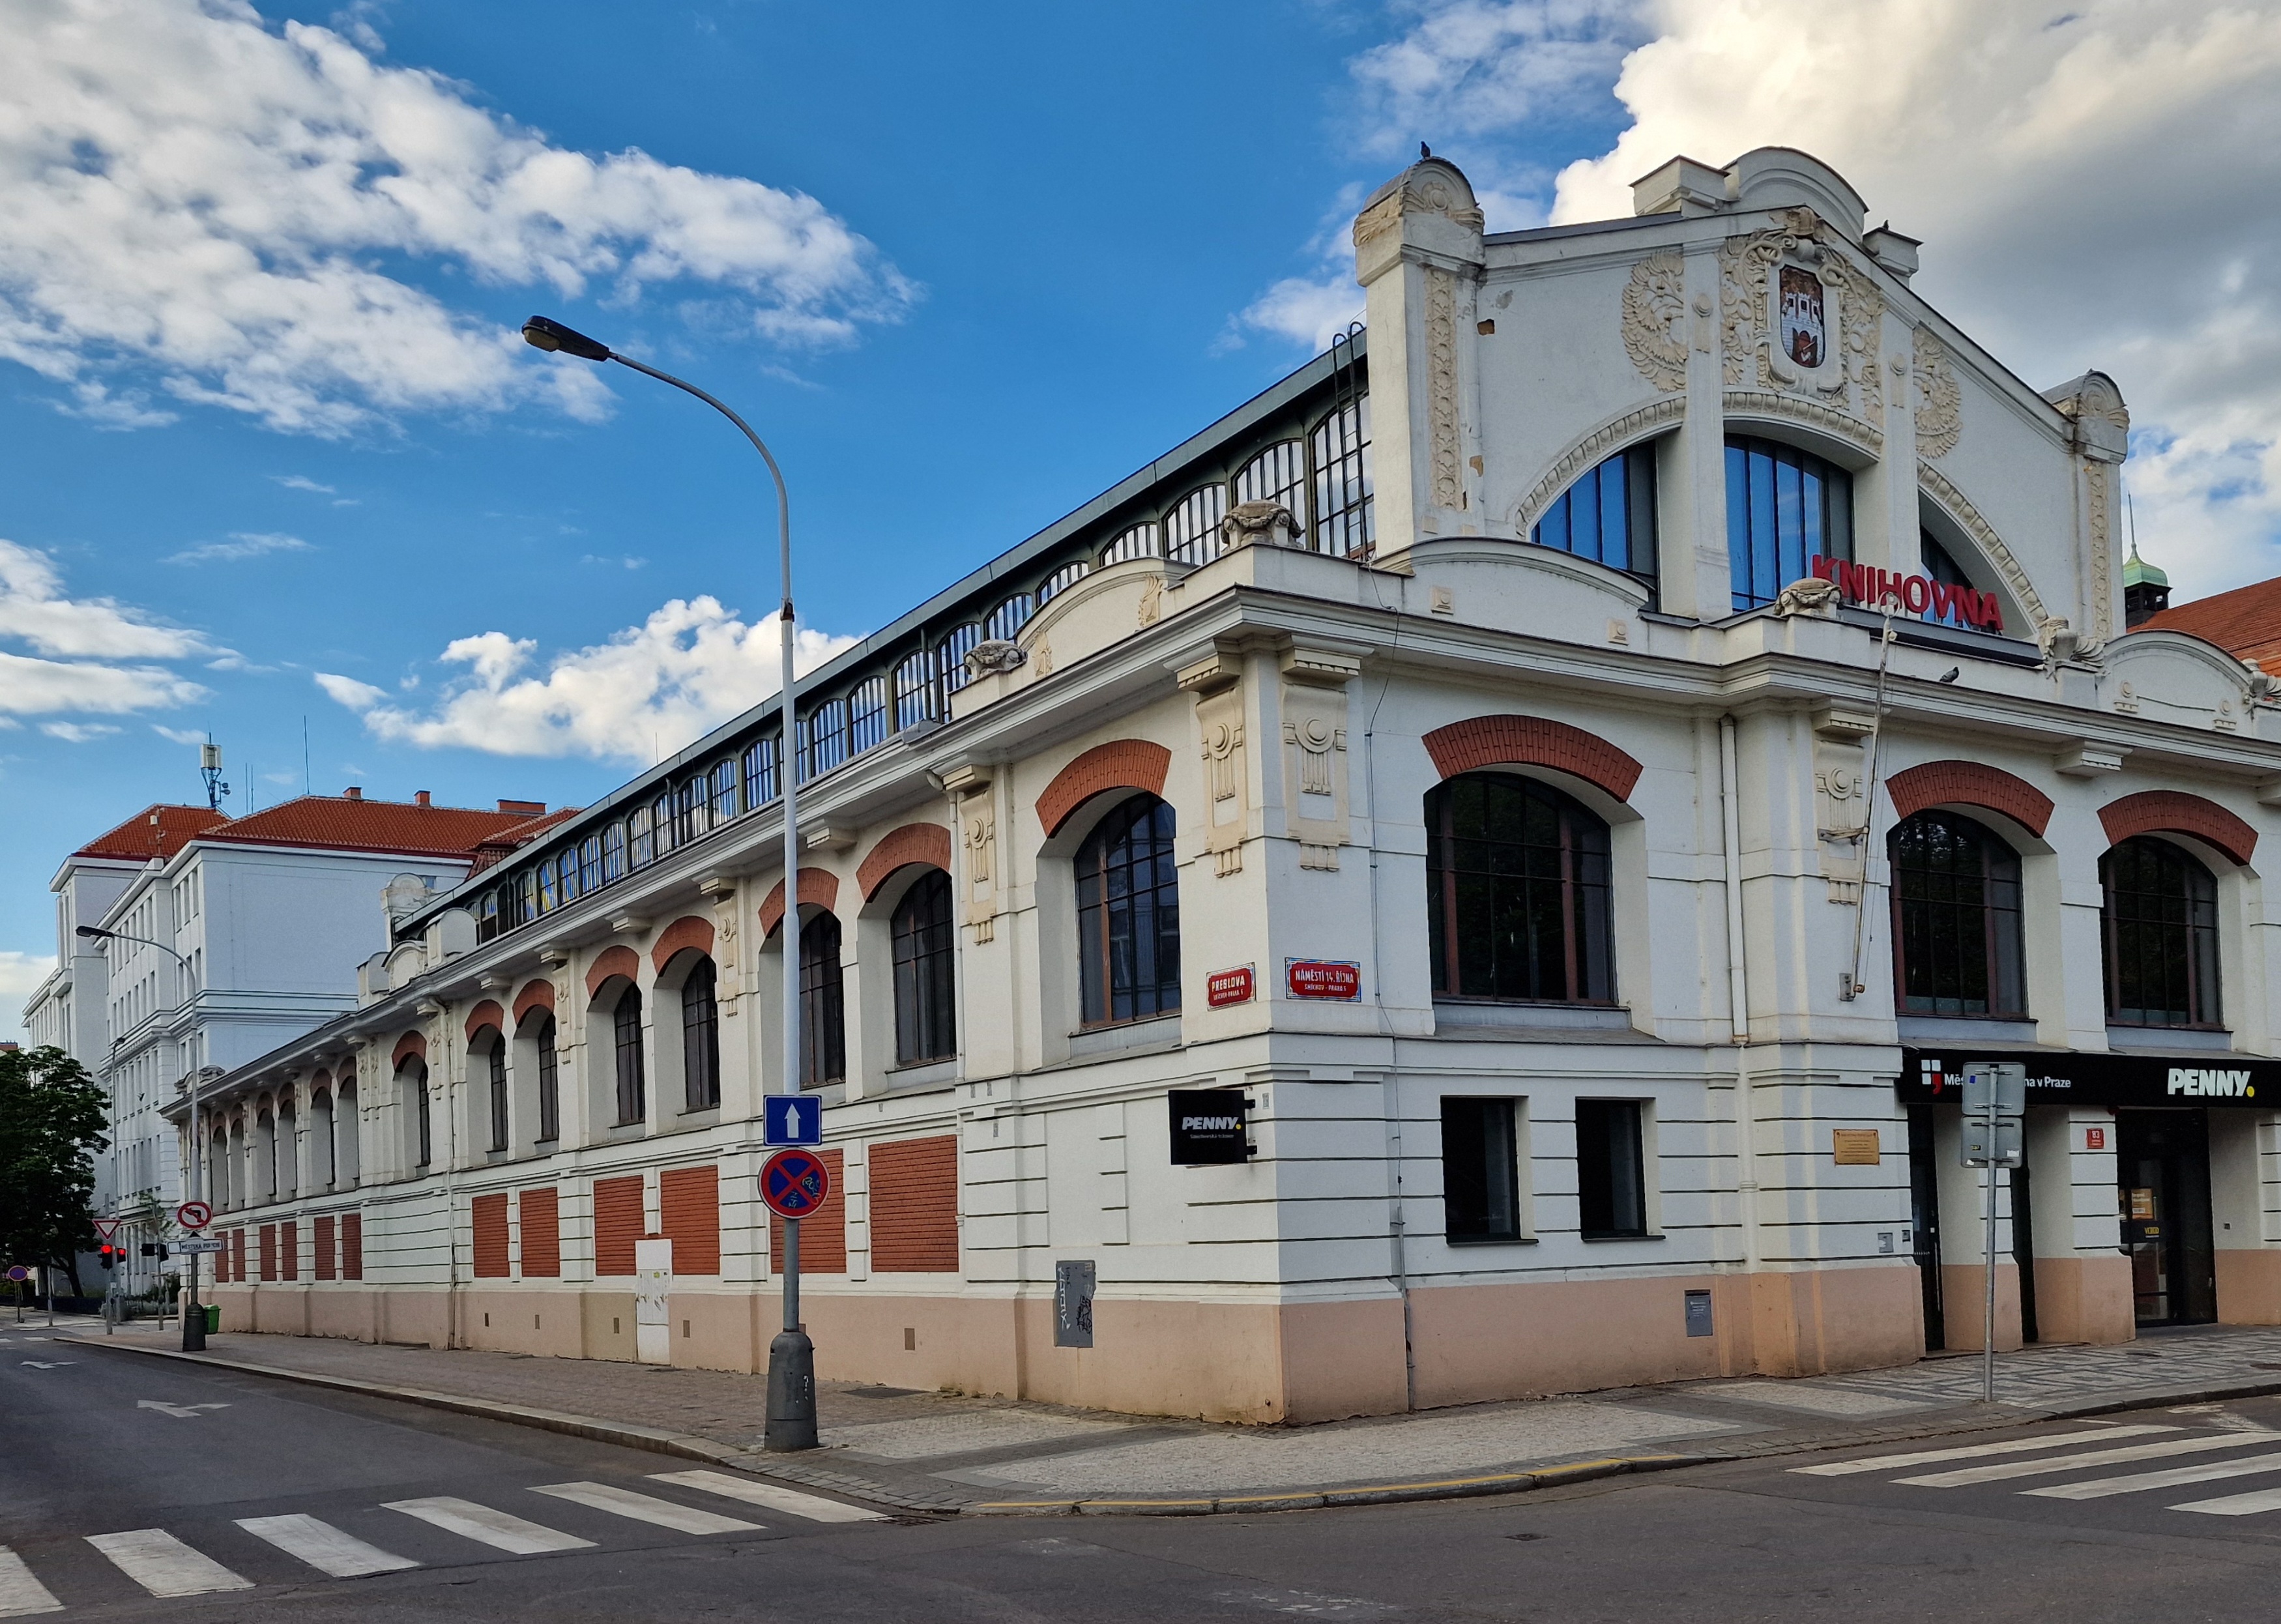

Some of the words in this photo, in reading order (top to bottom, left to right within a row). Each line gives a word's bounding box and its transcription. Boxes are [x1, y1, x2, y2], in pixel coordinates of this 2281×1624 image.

[1812, 554, 2004, 630] KNIHOVNA
[1295, 968, 1324, 982] NÁMĚSTÍ
[1326, 971, 1335, 983] 14.
[1336, 970, 1354, 983] ŘÍJNA
[1212, 975, 1245, 993] PRESLOVA
[2037, 1079, 2042, 1087] v
[2044, 1076, 2071, 1088] Praze
